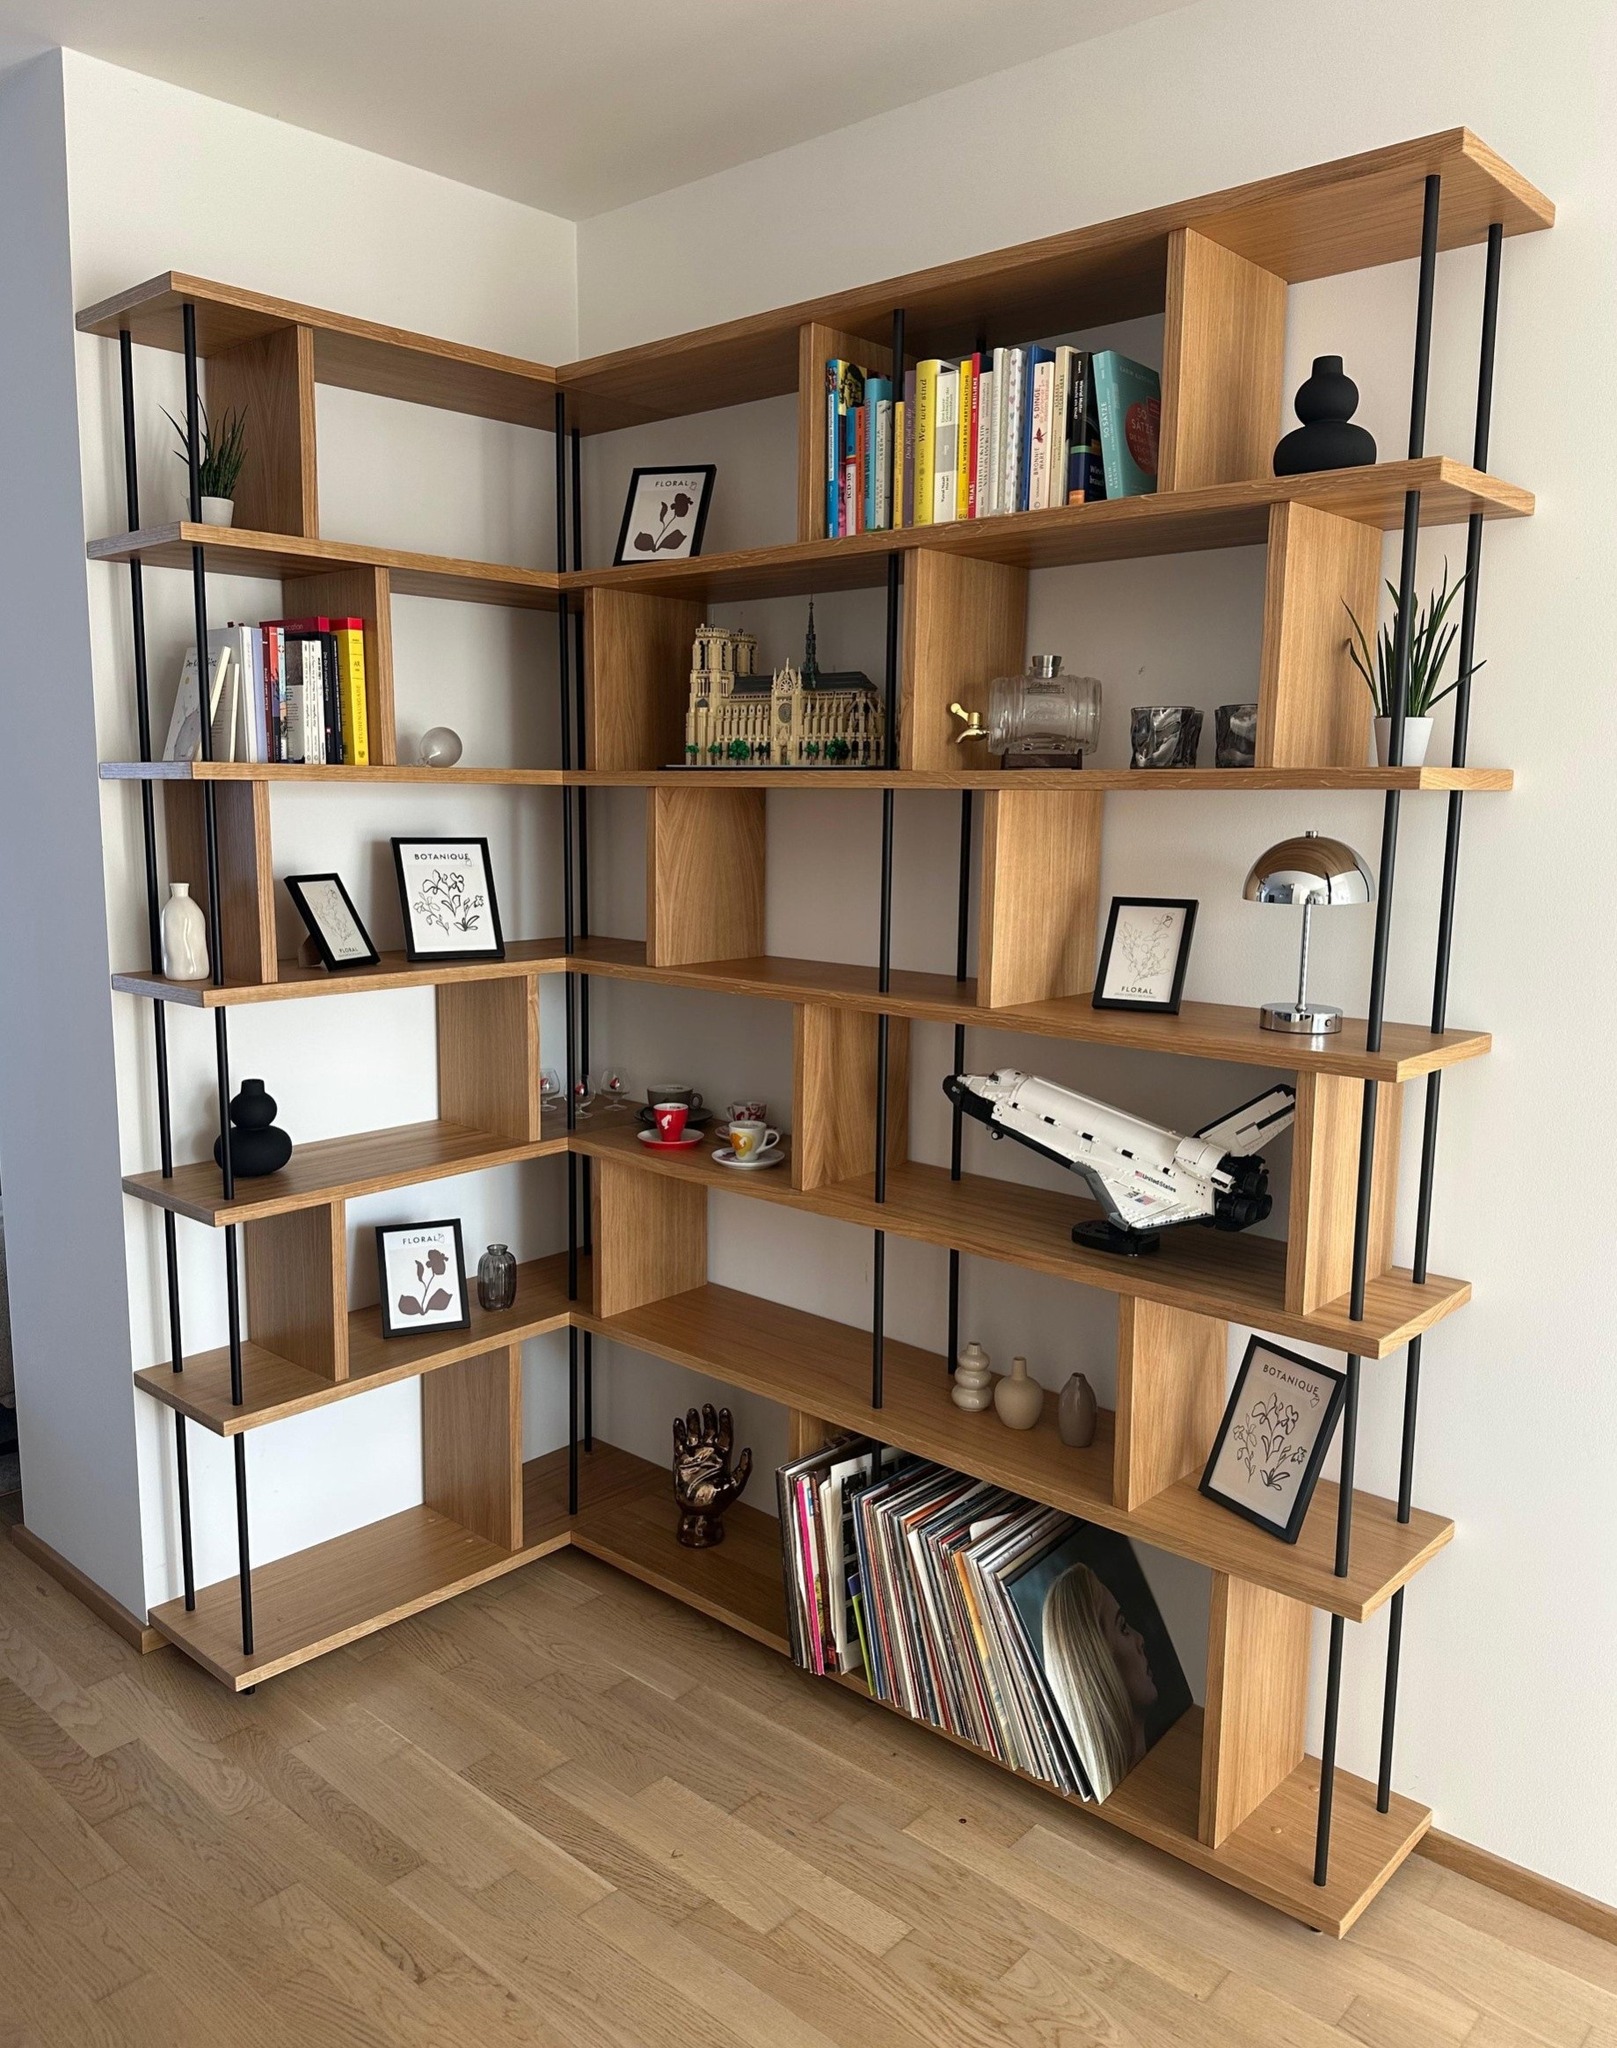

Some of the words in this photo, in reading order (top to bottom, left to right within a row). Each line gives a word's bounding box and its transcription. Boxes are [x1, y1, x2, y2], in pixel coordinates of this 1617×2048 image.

[1103, 427, 1110, 438] 50
[414, 853, 469, 862] BOTANIQUE
[1121, 986, 1153, 994] FLORAL
[1142, 1173, 1159, 1185] United
[1160, 1181, 1176, 1193] States
[403, 1235, 438, 1245] FLORAL
[1262, 1363, 1319, 1395] BOTANIQUE
